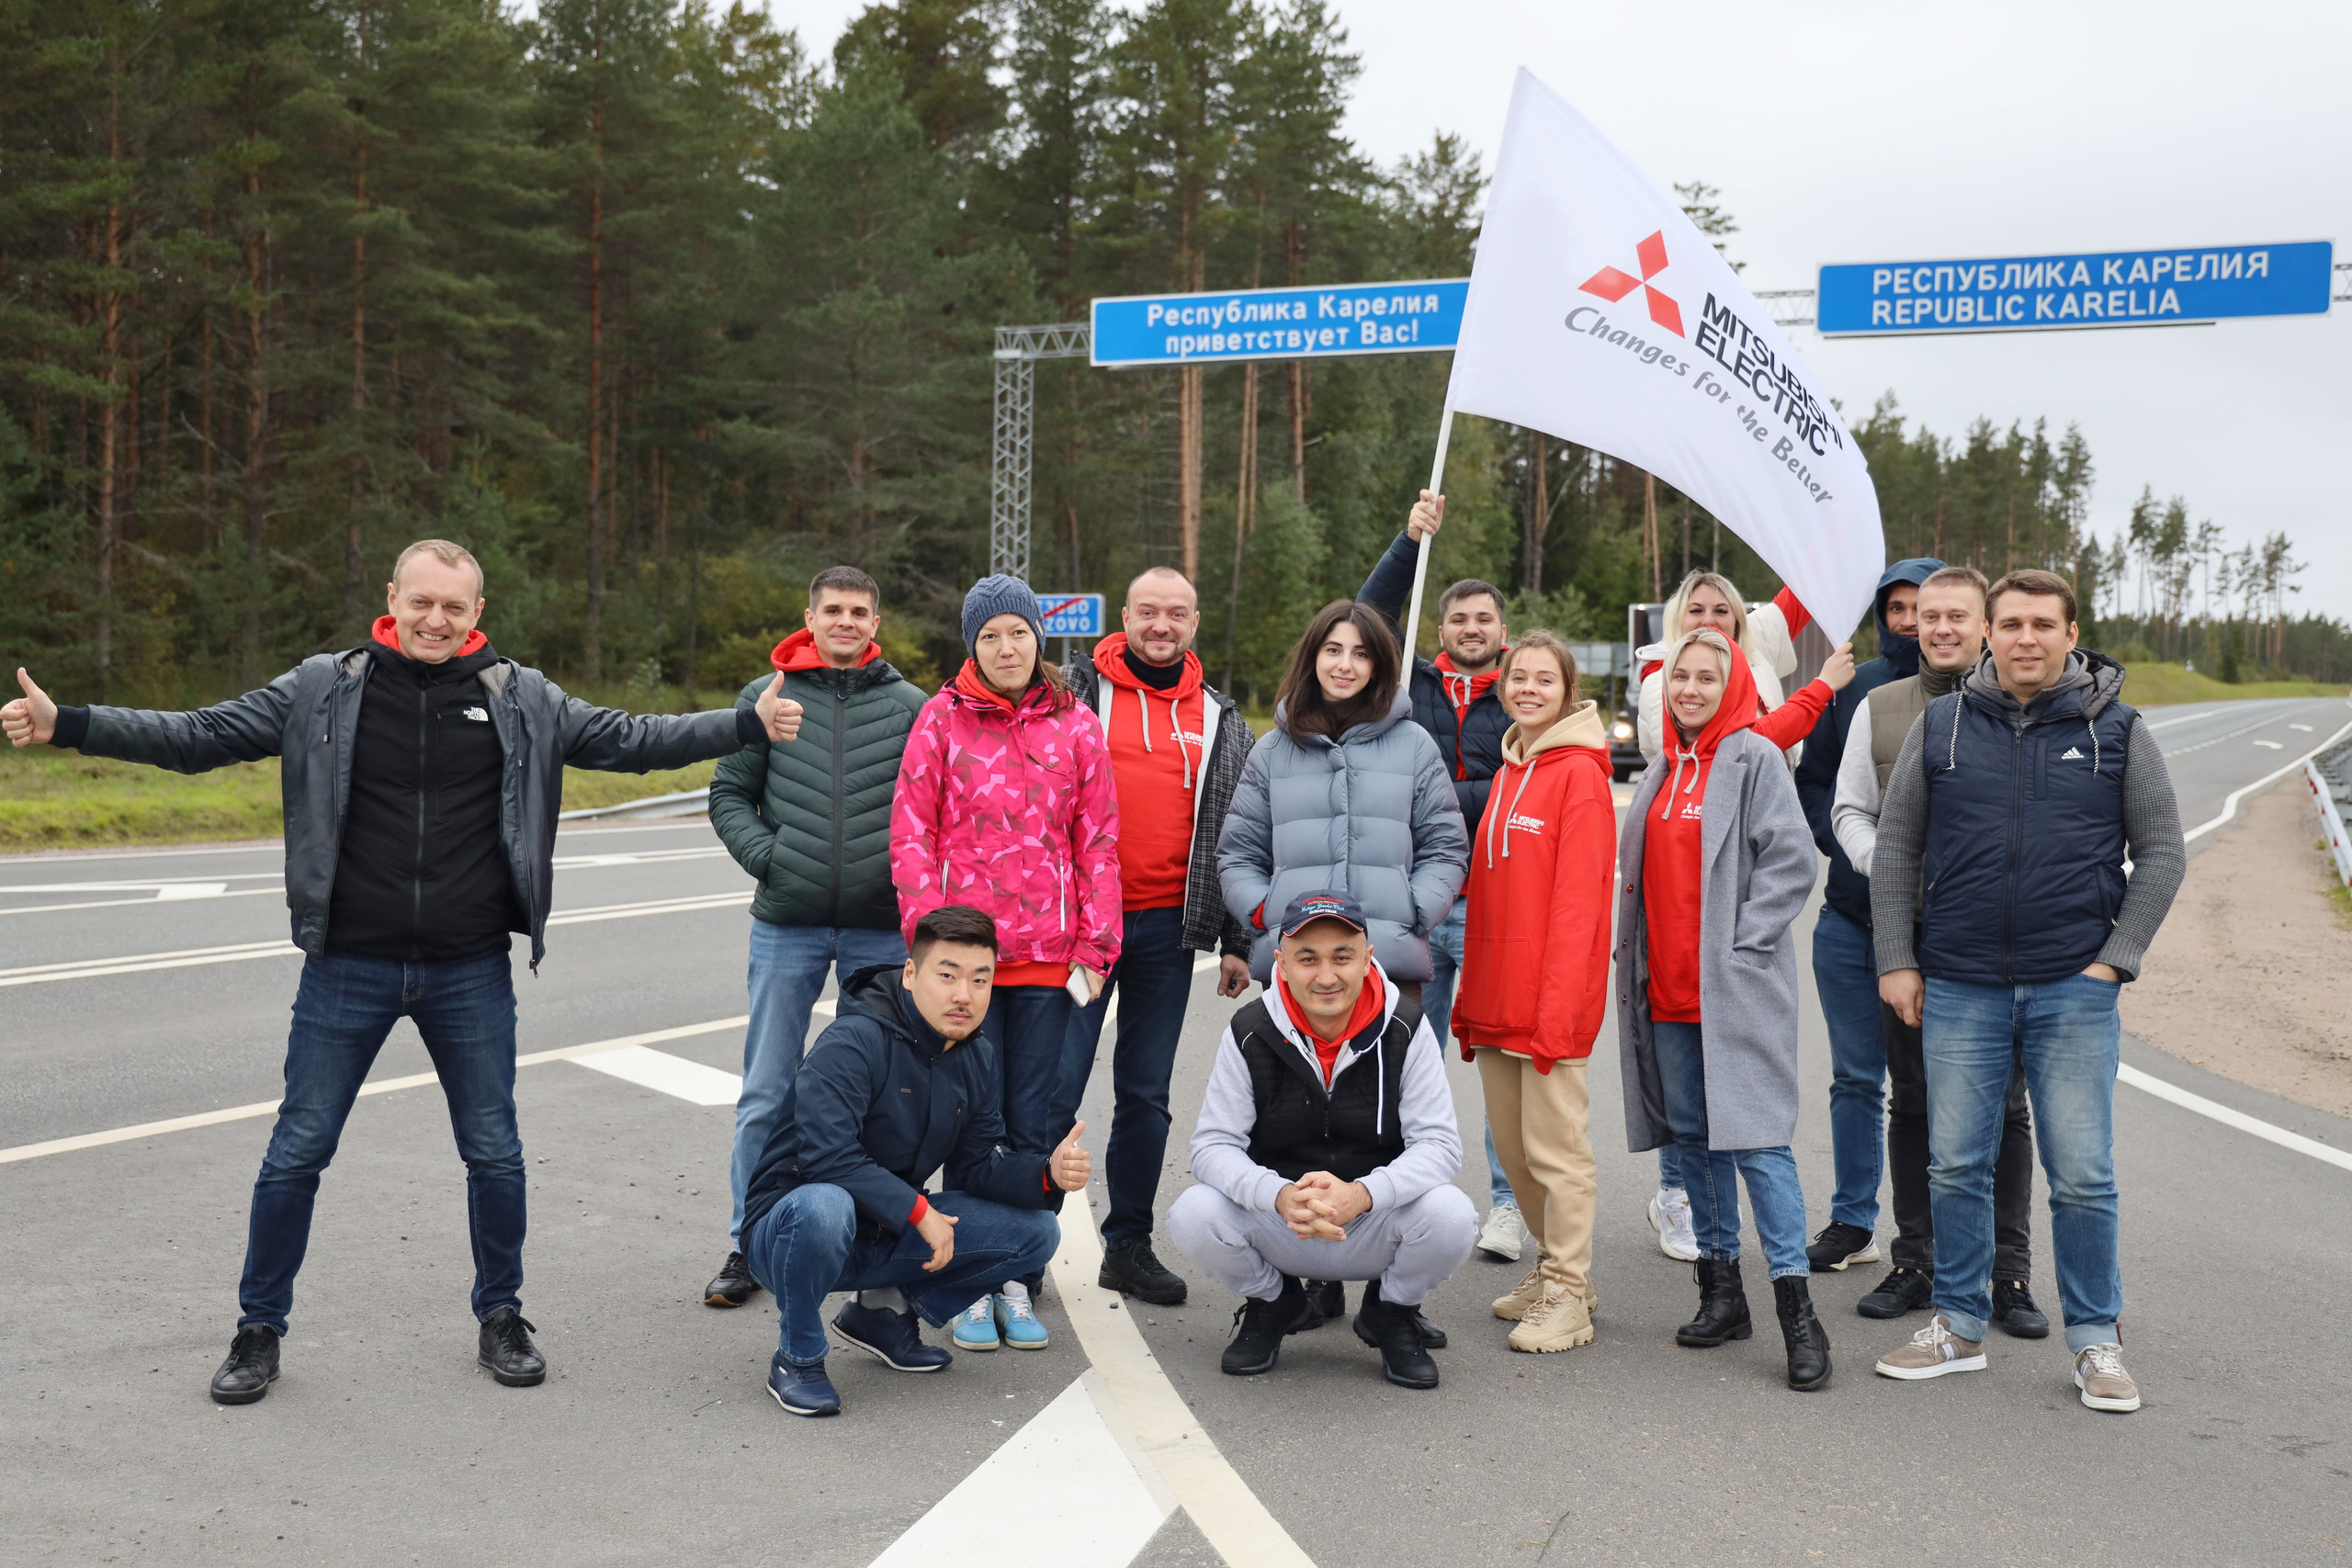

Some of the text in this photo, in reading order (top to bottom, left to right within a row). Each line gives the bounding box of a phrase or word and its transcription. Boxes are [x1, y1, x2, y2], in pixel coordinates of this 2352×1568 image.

[1872, 251, 2269, 295] РЕСПУБЛИКА КАРЕЛИЯ
[1147, 293, 1440, 329] Республика Карелия
[1871, 288, 2180, 325] REPUBLIC KARELIA
[1165, 318, 1419, 358] приветствует Вас!
[1694, 320, 1826, 457] ELECTRIC
[1702, 291, 1844, 451] MITSUBISHI
[1564, 306, 1834, 503] Changes for the Better
